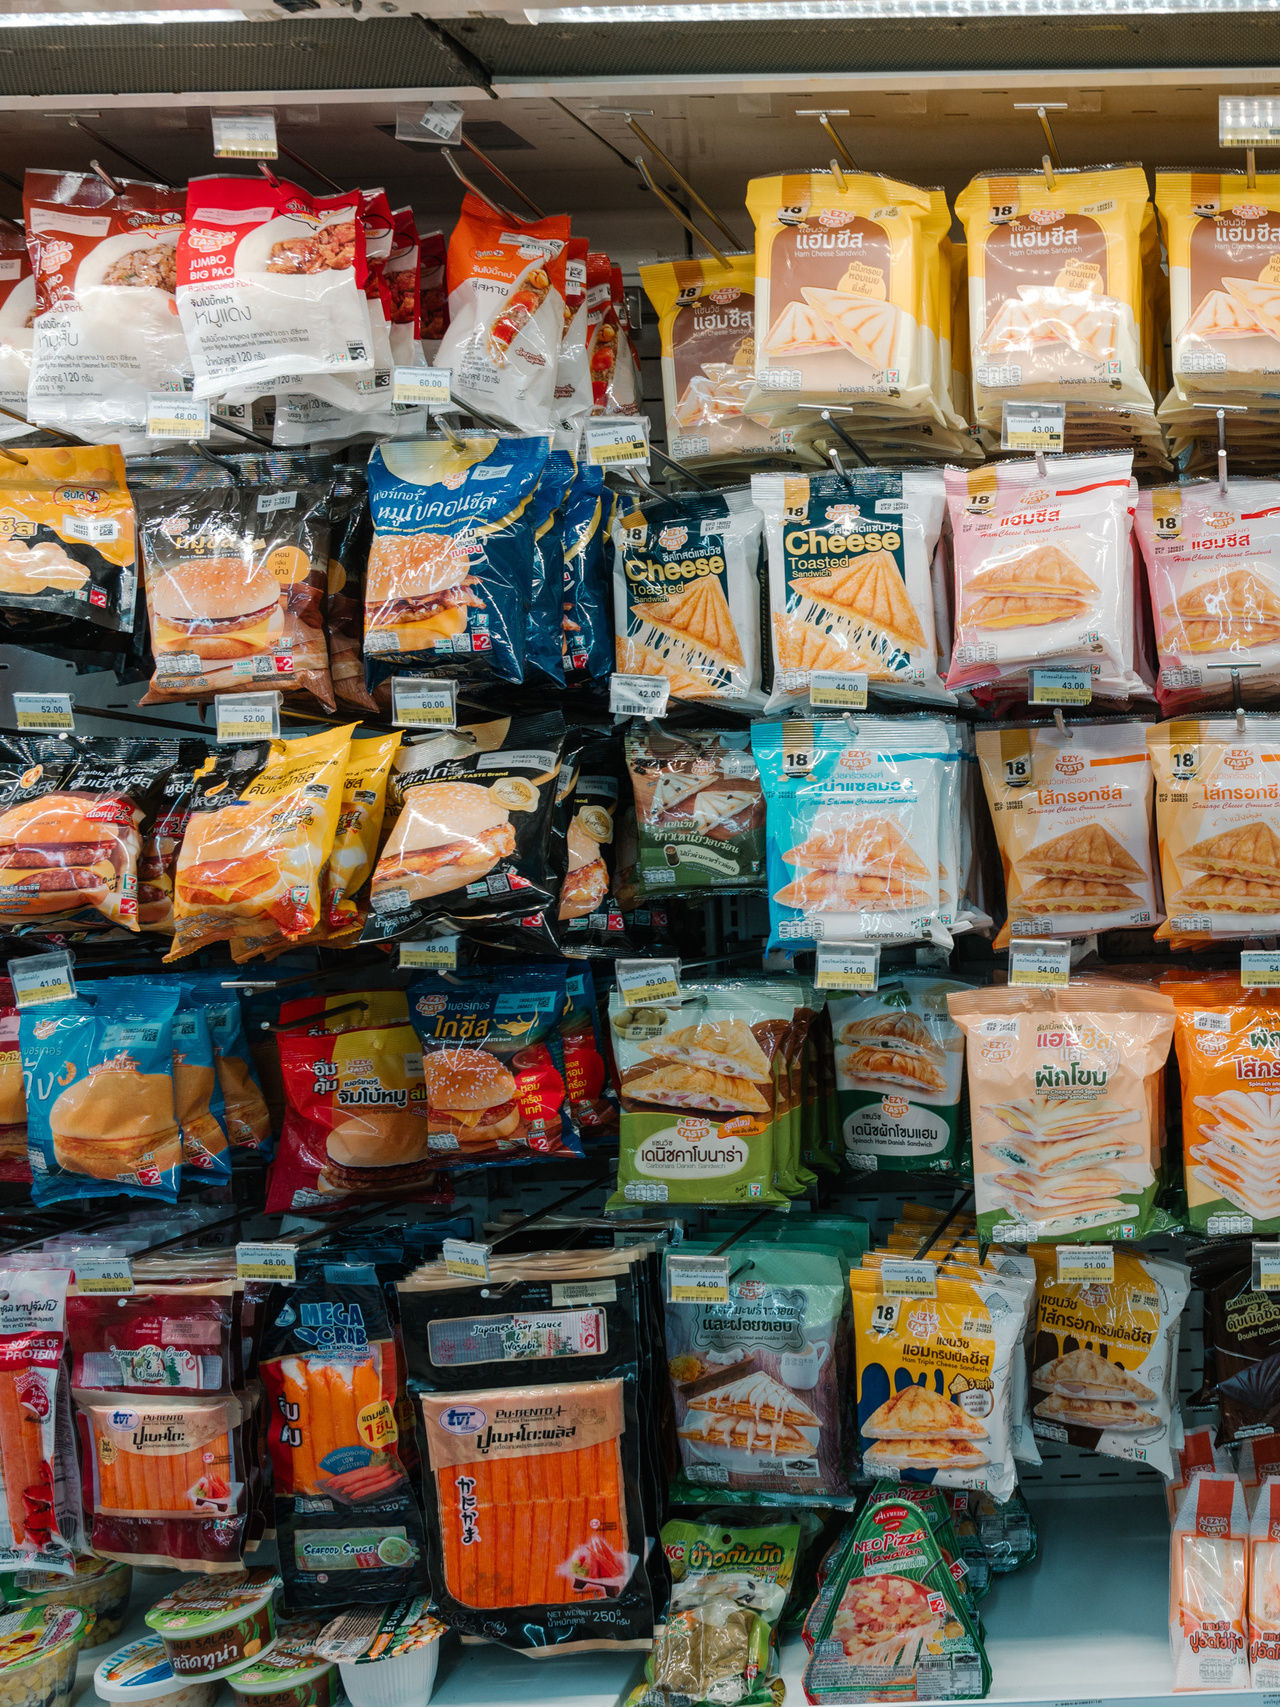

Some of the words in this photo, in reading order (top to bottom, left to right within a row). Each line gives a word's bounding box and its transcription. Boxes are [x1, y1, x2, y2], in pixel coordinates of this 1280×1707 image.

[796, 231, 863, 250] แฮมชีส
[189, 256, 226, 271] JUMBO
[189, 269, 211, 280] BIG
[212, 266, 235, 276] PAO
[1032, 425, 1054, 433] 43.00
[614, 436, 637, 445] 51.00
[786, 531, 900, 555] Cheese
[624, 555, 724, 581] Cheese
[788, 556, 849, 570] Toasted
[792, 568, 832, 578] Sandwich
[629, 581, 684, 595] Toasted
[634, 594, 669, 603] Sandwich
[836, 683, 858, 692] 44.00
[639, 690, 661, 700] 42.00
[41, 705, 64, 714] 52.00
[786, 753, 808, 765] 18
[1037, 786, 1122, 807] ไส้กรอกชีส
[426, 944, 449, 953] 48.00
[1038, 966, 1060, 974] 54.00
[646, 977, 667, 987] 49.00
[448, 1000, 490, 1012] เบอร์เกอร์
[435, 1014, 487, 1039] ไก่ชีส
[1035, 1065, 1108, 1089] ผักโขม
[684, 1118, 705, 1129] EZY
[678, 1127, 709, 1138] TASTE
[851, 1124, 938, 1141] เดนิชผักโขมแฮม
[641, 1142, 744, 1165] เดนิชคาโบนาร่า
[458, 1256, 480, 1267] 118.00
[101, 1271, 124, 1280] 48.00
[696, 1280, 719, 1289] 44.00
[1041, 1296, 1078, 1311] แซนวิช
[301, 1303, 363, 1326] MEGA
[876, 1305, 894, 1318] 18
[474, 1322, 513, 1335] Japanese
[515, 1322, 533, 1333] Soy
[535, 1321, 563, 1330] Sauce
[318, 1326, 368, 1346] CRAB
[1237, 1330, 1263, 1342] Double
[504, 1341, 537, 1352] Wasabi
[854, 1538, 880, 1554] NEO
[880, 1530, 928, 1553] Pizza
[304, 1545, 339, 1555] SEAFOOD
[342, 1545, 375, 1553] SAUCE
[863, 1548, 922, 1564] Hawaiian
[547, 1612, 563, 1620] NET
[565, 1609, 592, 1619] WEIGHT
[593, 1610, 616, 1623] 250
